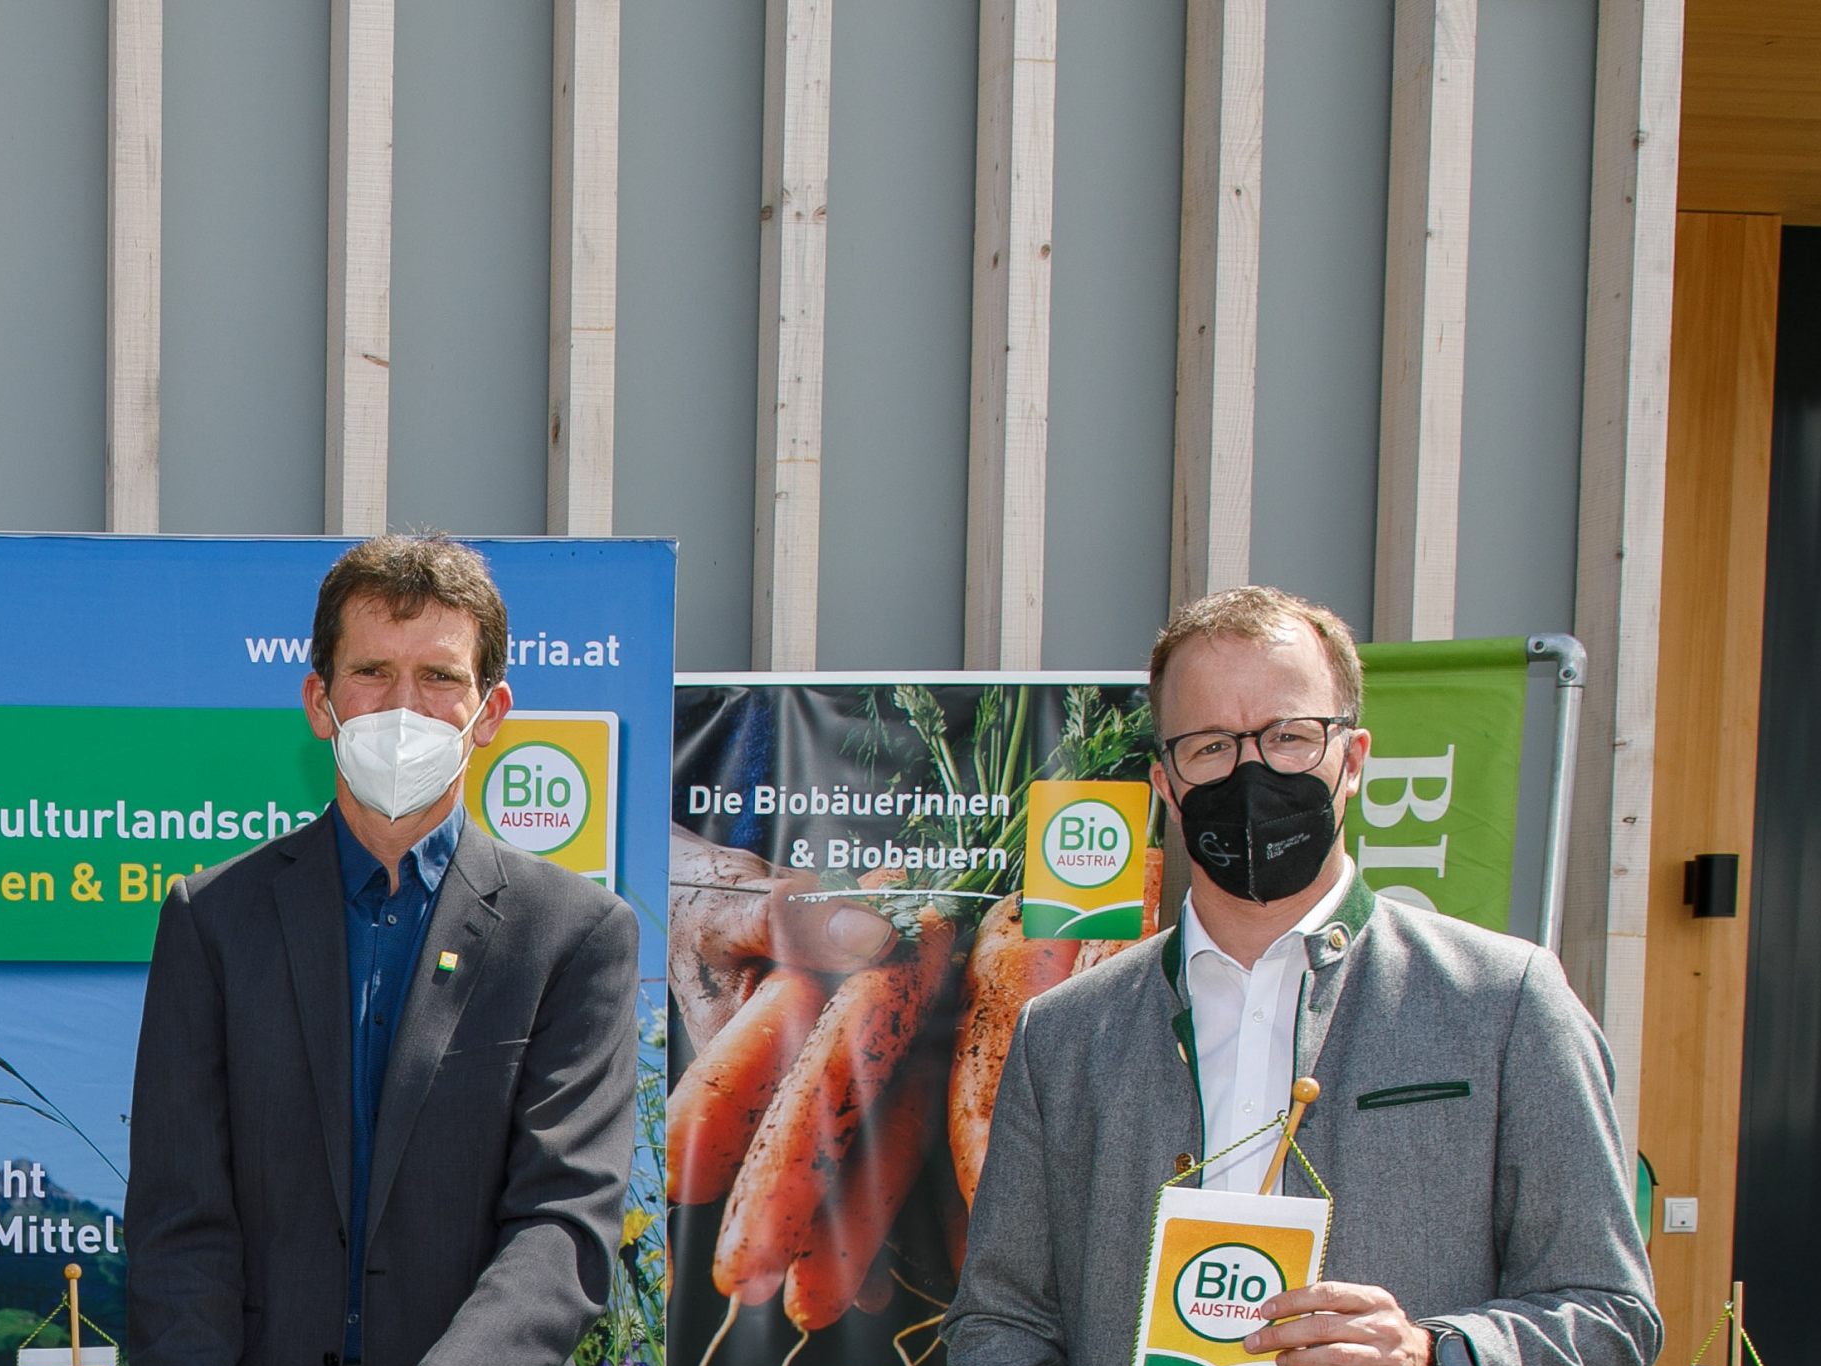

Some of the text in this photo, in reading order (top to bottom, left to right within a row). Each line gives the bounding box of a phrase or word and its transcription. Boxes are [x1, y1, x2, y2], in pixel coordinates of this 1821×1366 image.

[503, 764, 571, 808] Bio
[689, 785, 1010, 817] Die Biobäuerinnen
[500, 812, 571, 828] AUSTRIA
[1059, 816, 1118, 851] Bio
[789, 838, 1007, 870] & Biobauern
[1057, 855, 1117, 867] AUSTRIA
[71, 862, 105, 901] &
[1195, 1261, 1266, 1303] Bio
[1189, 1302, 1262, 1320] AUSTRIA
